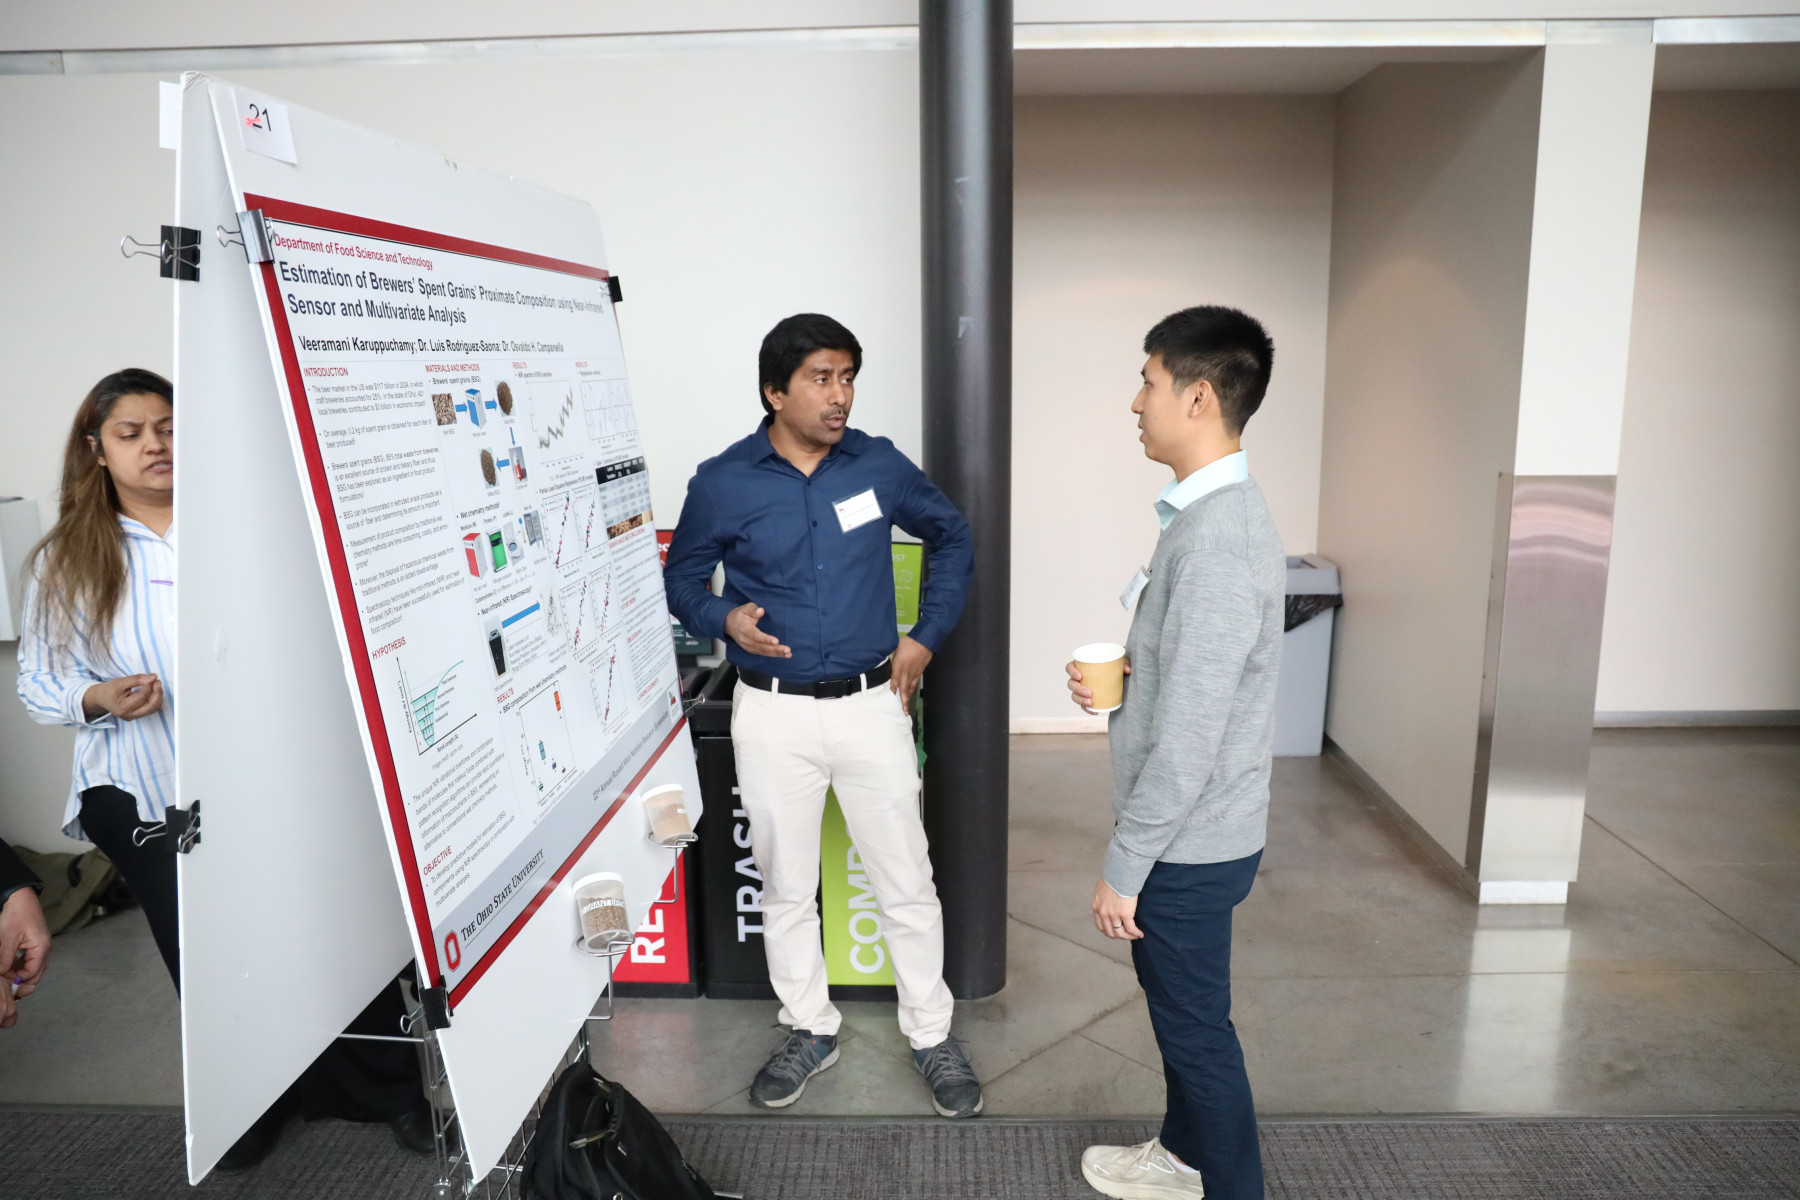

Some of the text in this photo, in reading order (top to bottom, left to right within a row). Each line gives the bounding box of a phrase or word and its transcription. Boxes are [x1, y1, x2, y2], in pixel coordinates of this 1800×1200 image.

[249, 103, 272, 132] 21
[274, 234, 433, 271] Department of Food Science and Technology
[279, 261, 353, 287] Estimation
[355, 270, 368, 288] of
[418, 277, 447, 299] Spent
[478, 285, 515, 304] Proximate
[516, 290, 556, 309] Composition
[557, 297, 574, 313] using
[287, 293, 466, 327] Sensor and Multivariate Analysis
[298, 336, 351, 351] Veeramani
[417, 338, 429, 352] Dr.
[429, 339, 446, 352] Luis
[501, 340, 509, 352] Dr.
[510, 340, 531, 352] Osvaldo
[531, 342, 537, 352] H.
[536, 341, 564, 353] Campanella
[304, 367, 349, 377] INTRODUCTION
[425, 364, 480, 373] MATERIALS AND METHODS
[372, 636, 406, 660] HYPOTHESIS
[497, 687, 514, 704] RESULTS
[423, 845, 452, 876] OBJECTIVE
[460, 849, 543, 941] THE OHIO STATE UNIVERSITY
[847, 824, 885, 974] COMP
[630, 888, 666, 964] RE
